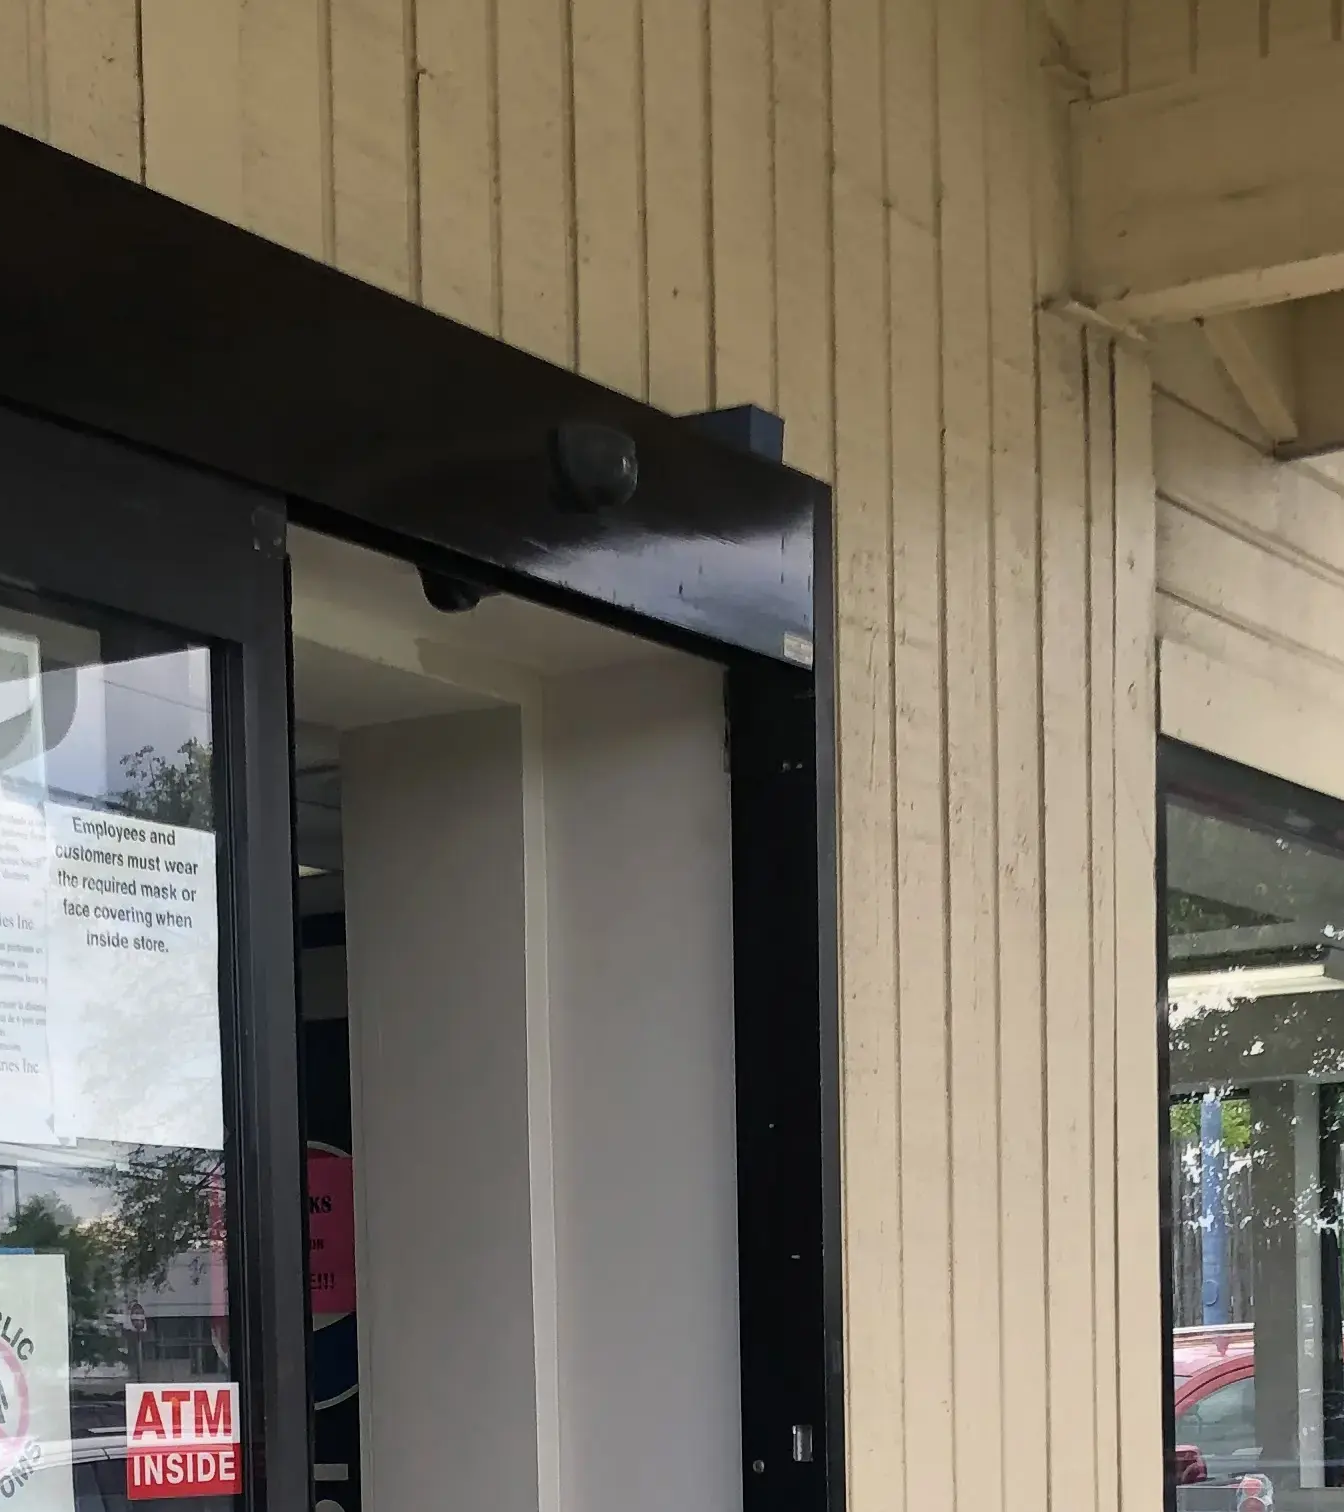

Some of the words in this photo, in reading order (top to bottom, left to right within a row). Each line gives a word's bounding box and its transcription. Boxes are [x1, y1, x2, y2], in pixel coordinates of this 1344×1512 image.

[71, 816, 146, 843] Employees
[150, 830, 176, 847] and
[55, 845, 124, 867] customers
[127, 855, 161, 872] must
[164, 860, 199, 876] wear
[57, 869, 79, 888] the
[82, 876, 137, 896] required
[140, 883, 177, 902] mask
[181, 888, 197, 902] or
[63, 898, 90, 918] face
[93, 906, 153, 929] covering
[156, 911, 193, 929] when
[86, 930, 129, 949] inside
[133, 936, 170, 953] store.
[132, 1389, 234, 1441] ATM
[133, 1451, 236, 1487] INSIDE
